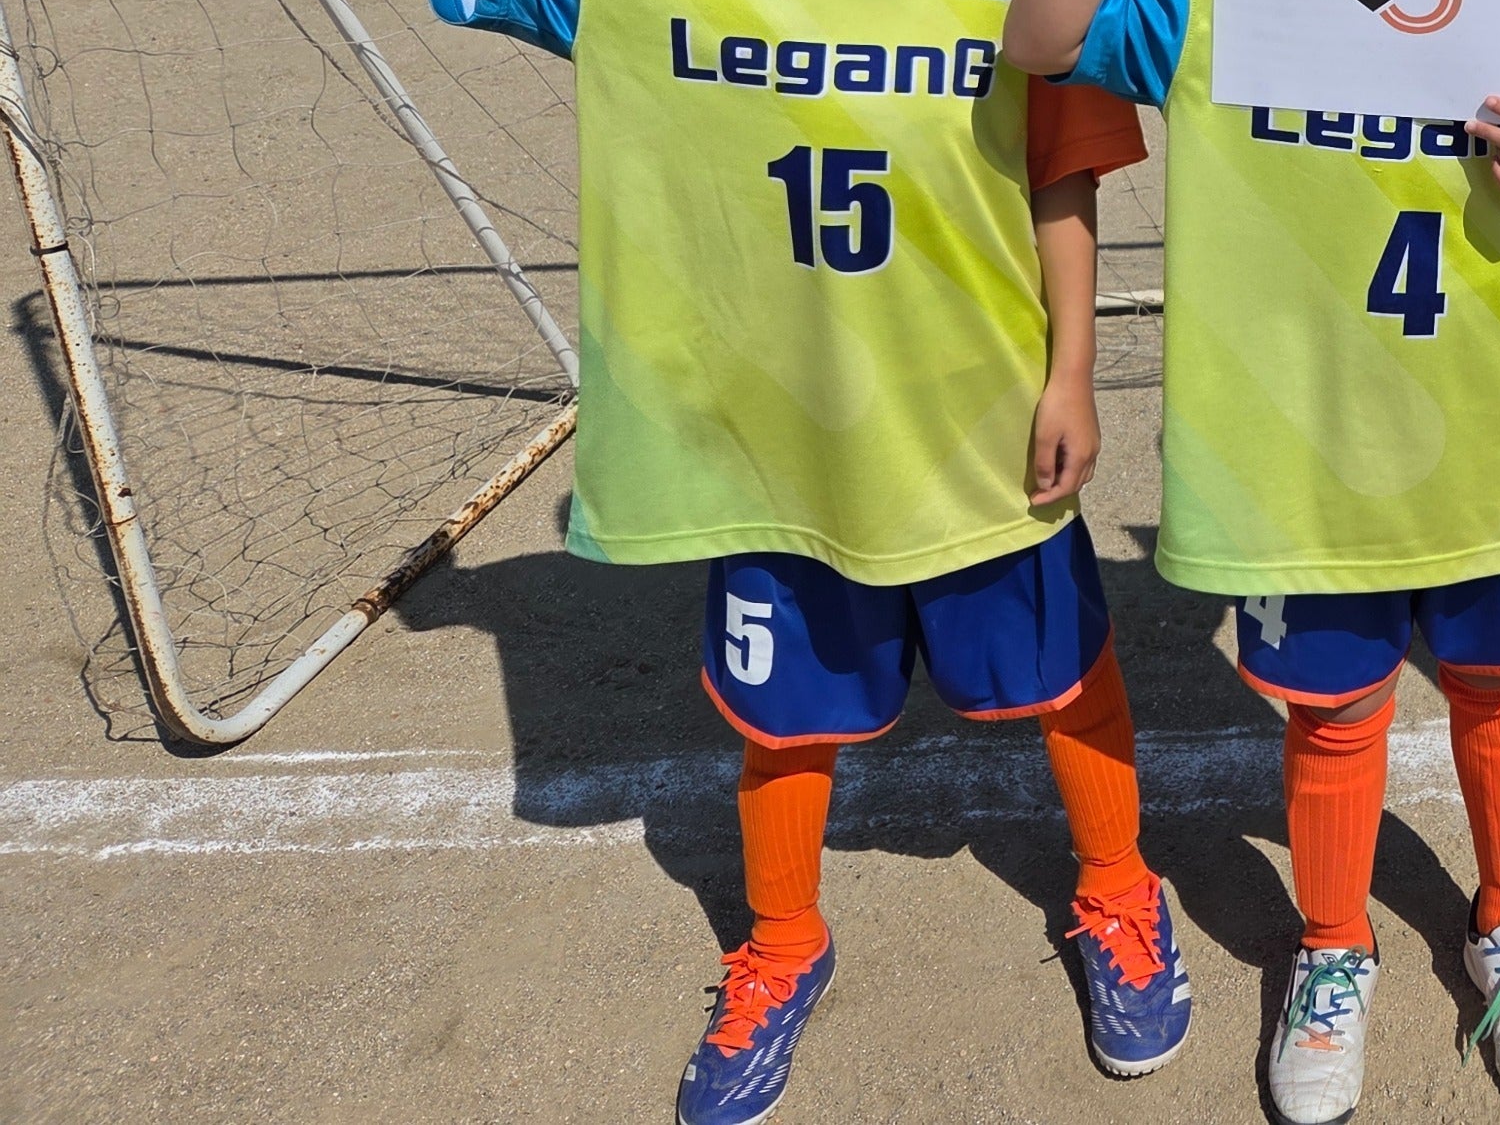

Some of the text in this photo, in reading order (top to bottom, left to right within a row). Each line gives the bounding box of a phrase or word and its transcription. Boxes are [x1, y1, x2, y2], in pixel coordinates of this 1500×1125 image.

[670, 17, 998, 99] LeganG
[767, 145, 892, 275] 15
[1366, 210, 1447, 338] 4
[725, 591, 774, 686] 5
